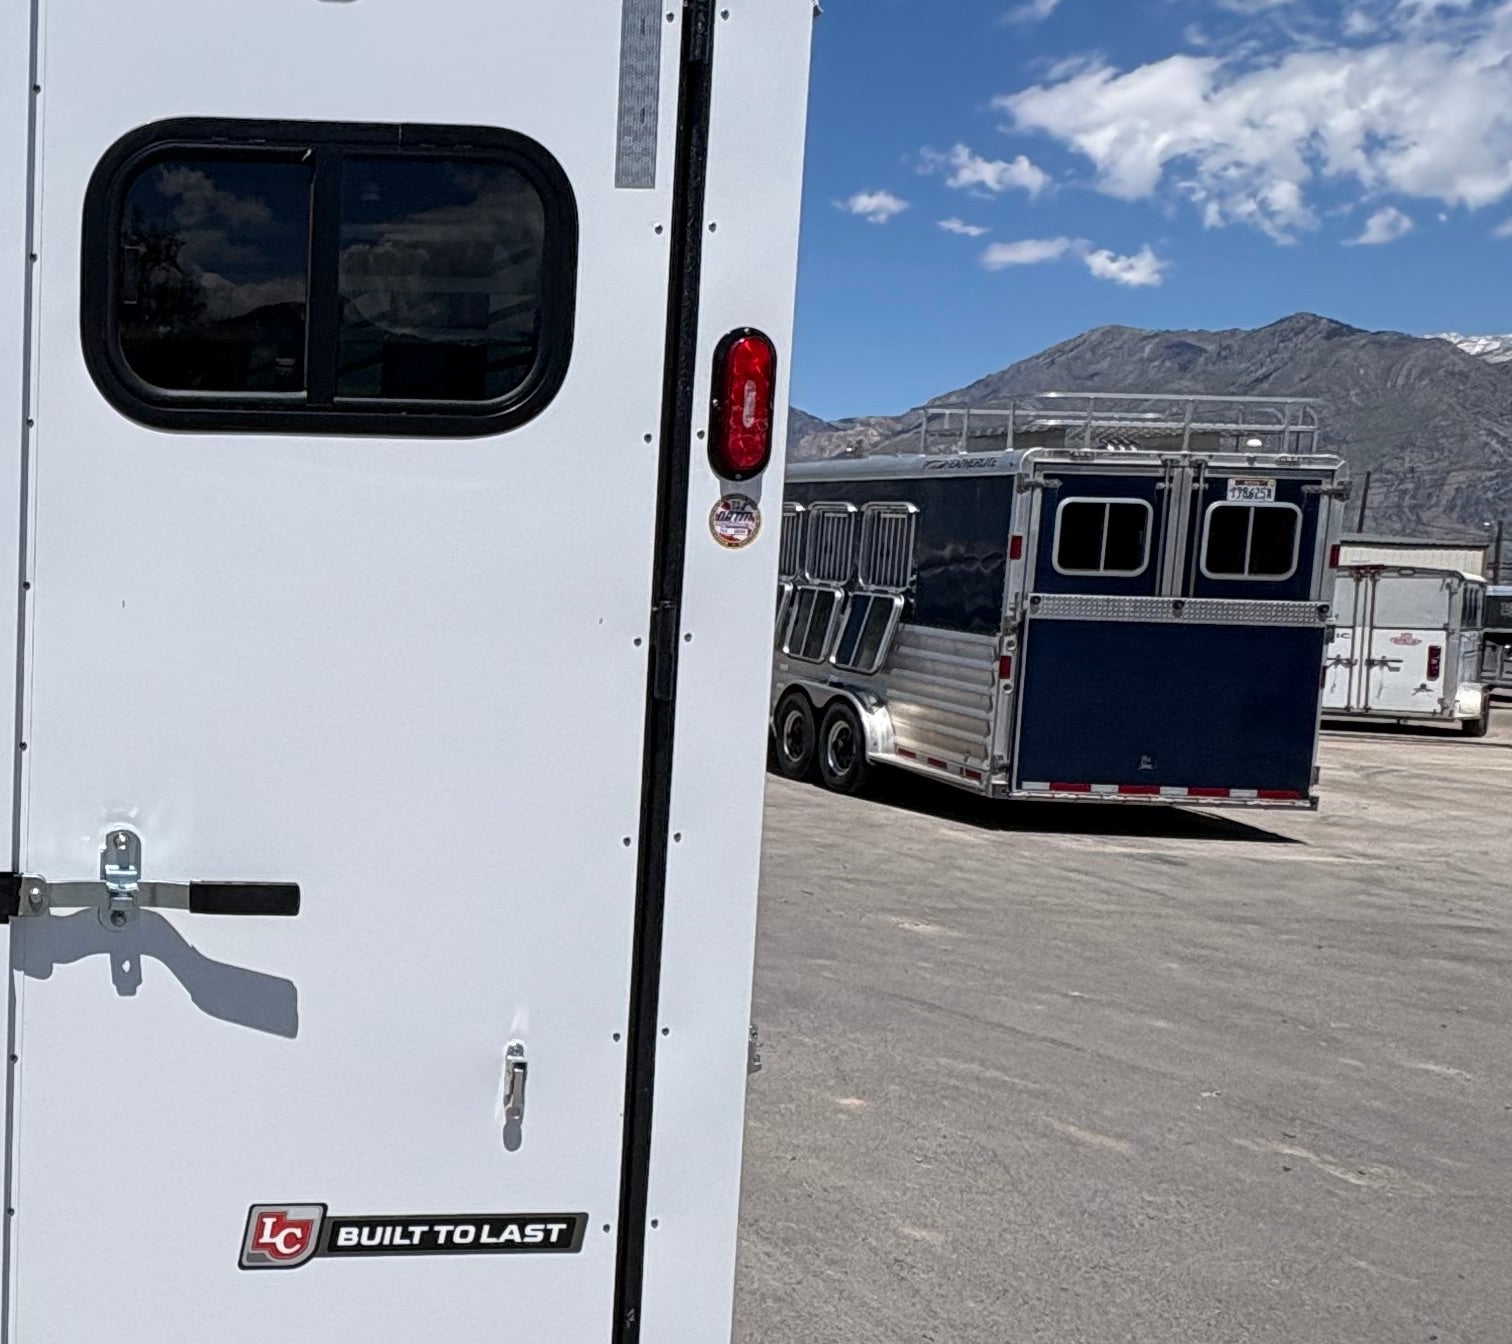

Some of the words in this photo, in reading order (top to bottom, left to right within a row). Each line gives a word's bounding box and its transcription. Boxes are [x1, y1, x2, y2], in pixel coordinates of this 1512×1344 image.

[258, 1216, 303, 1254] LC
[337, 1225, 429, 1247] BUILT
[433, 1224, 475, 1245] TO
[478, 1223, 568, 1244] LAST
